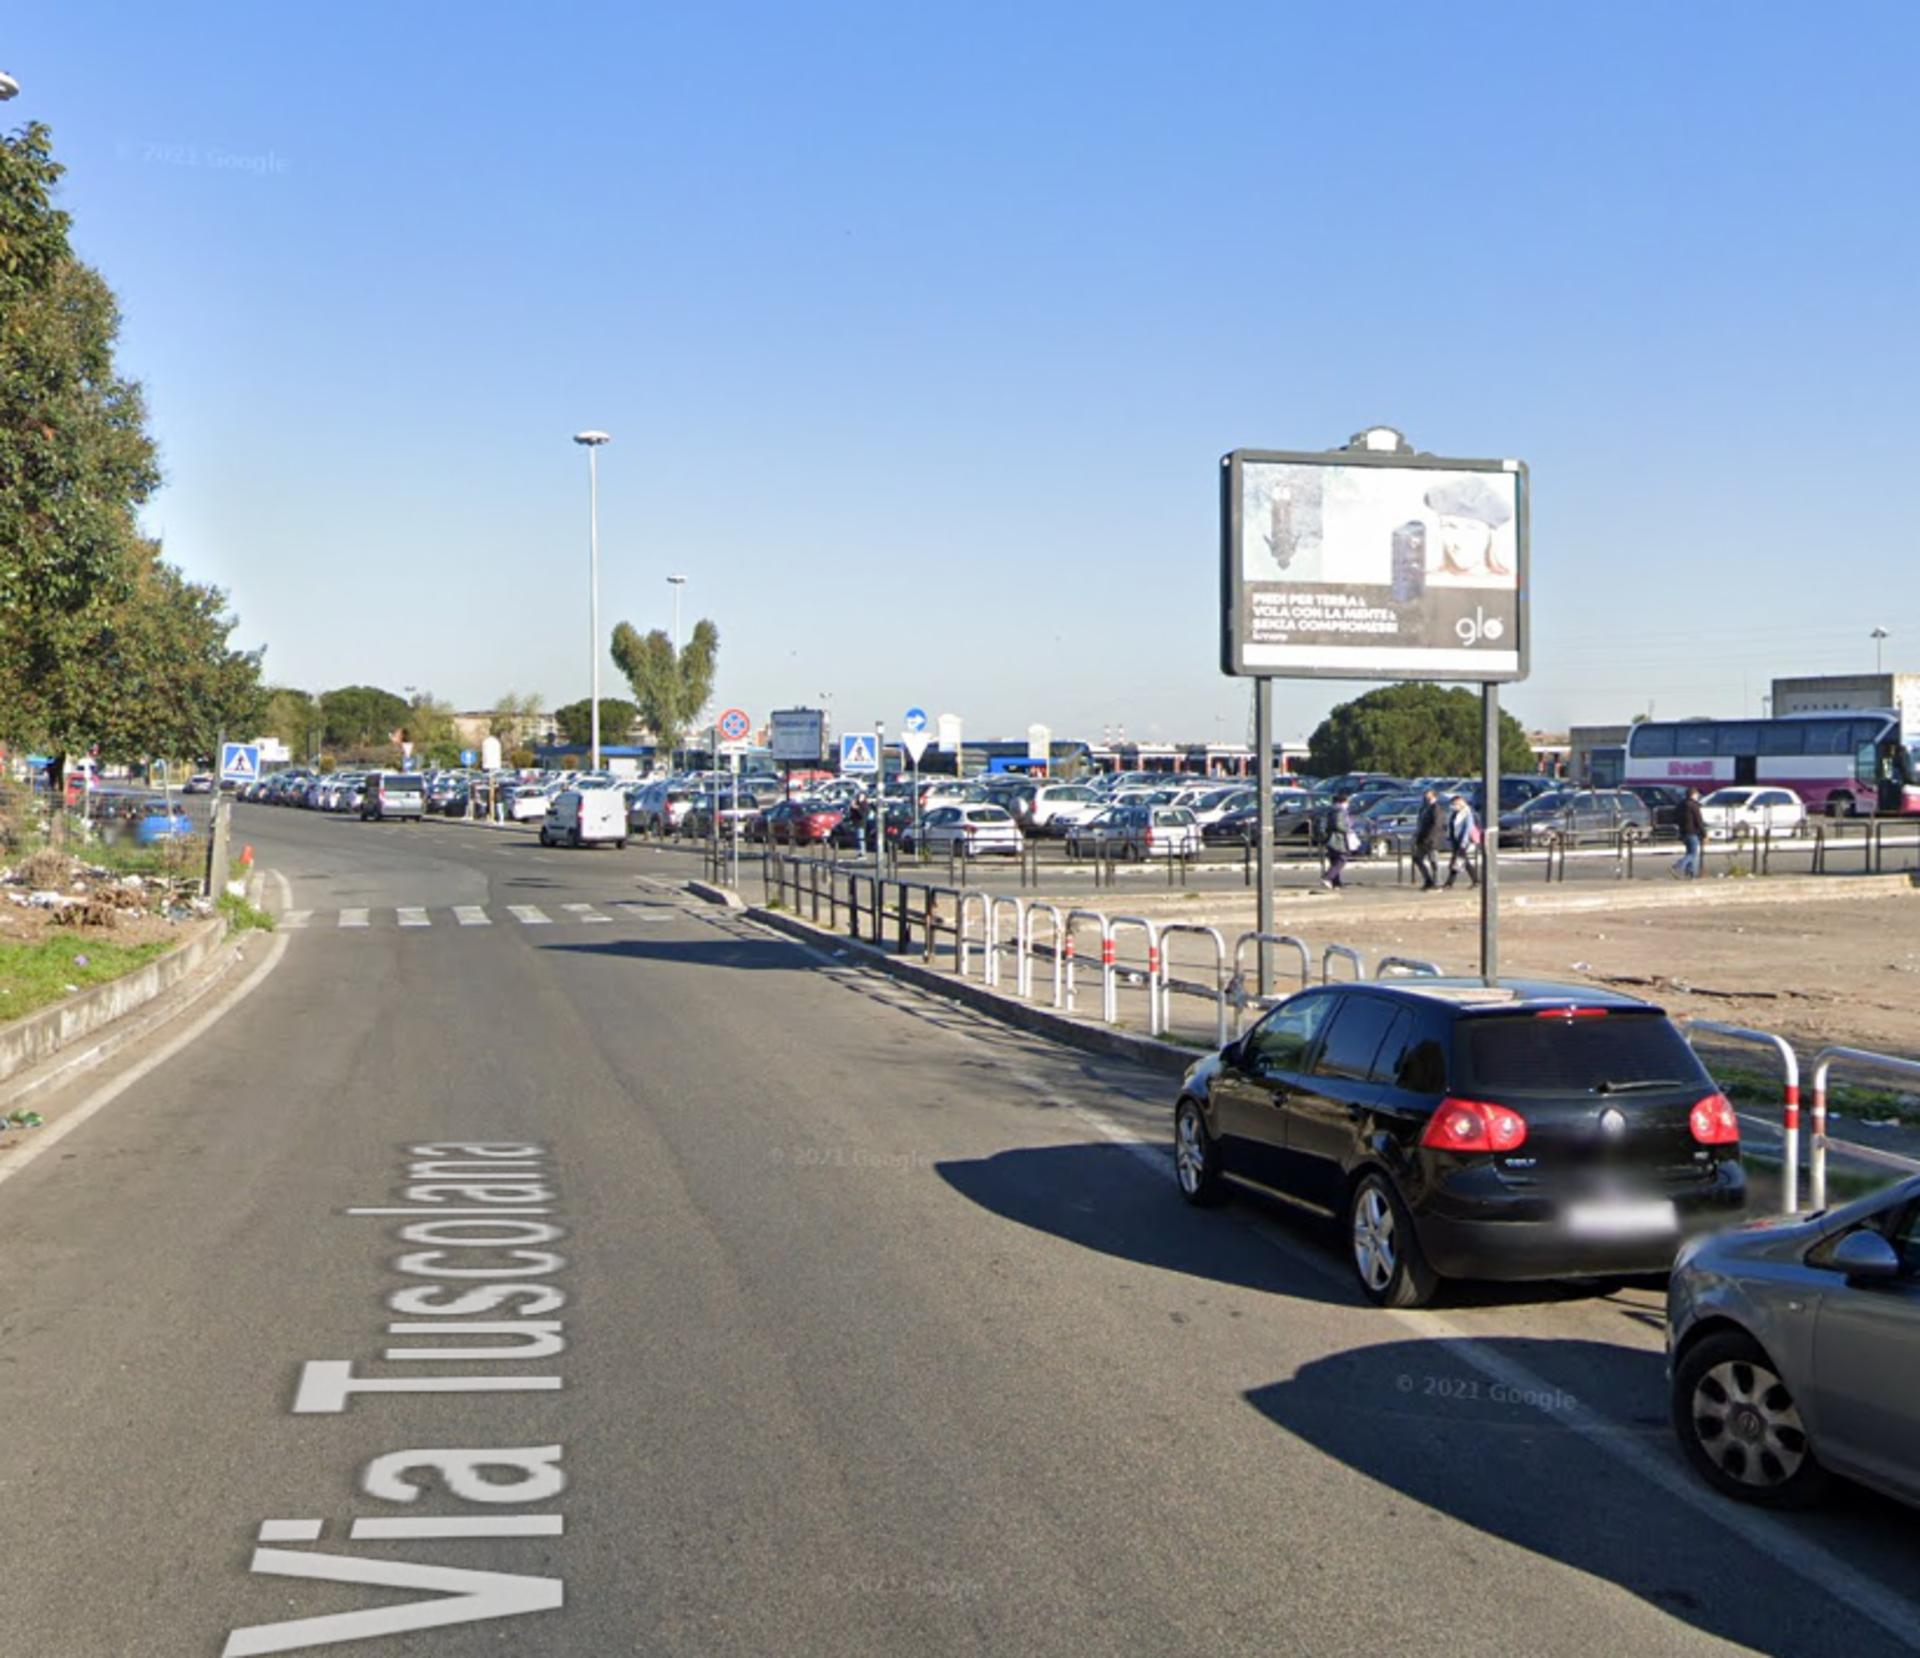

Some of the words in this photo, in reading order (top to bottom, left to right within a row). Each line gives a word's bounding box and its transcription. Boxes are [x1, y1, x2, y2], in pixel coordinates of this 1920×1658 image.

[1252, 606, 1290, 617] VOLA
[1291, 606, 1322, 619] CON
[1324, 606, 1342, 619] LA
[1456, 606, 1504, 646] glo
